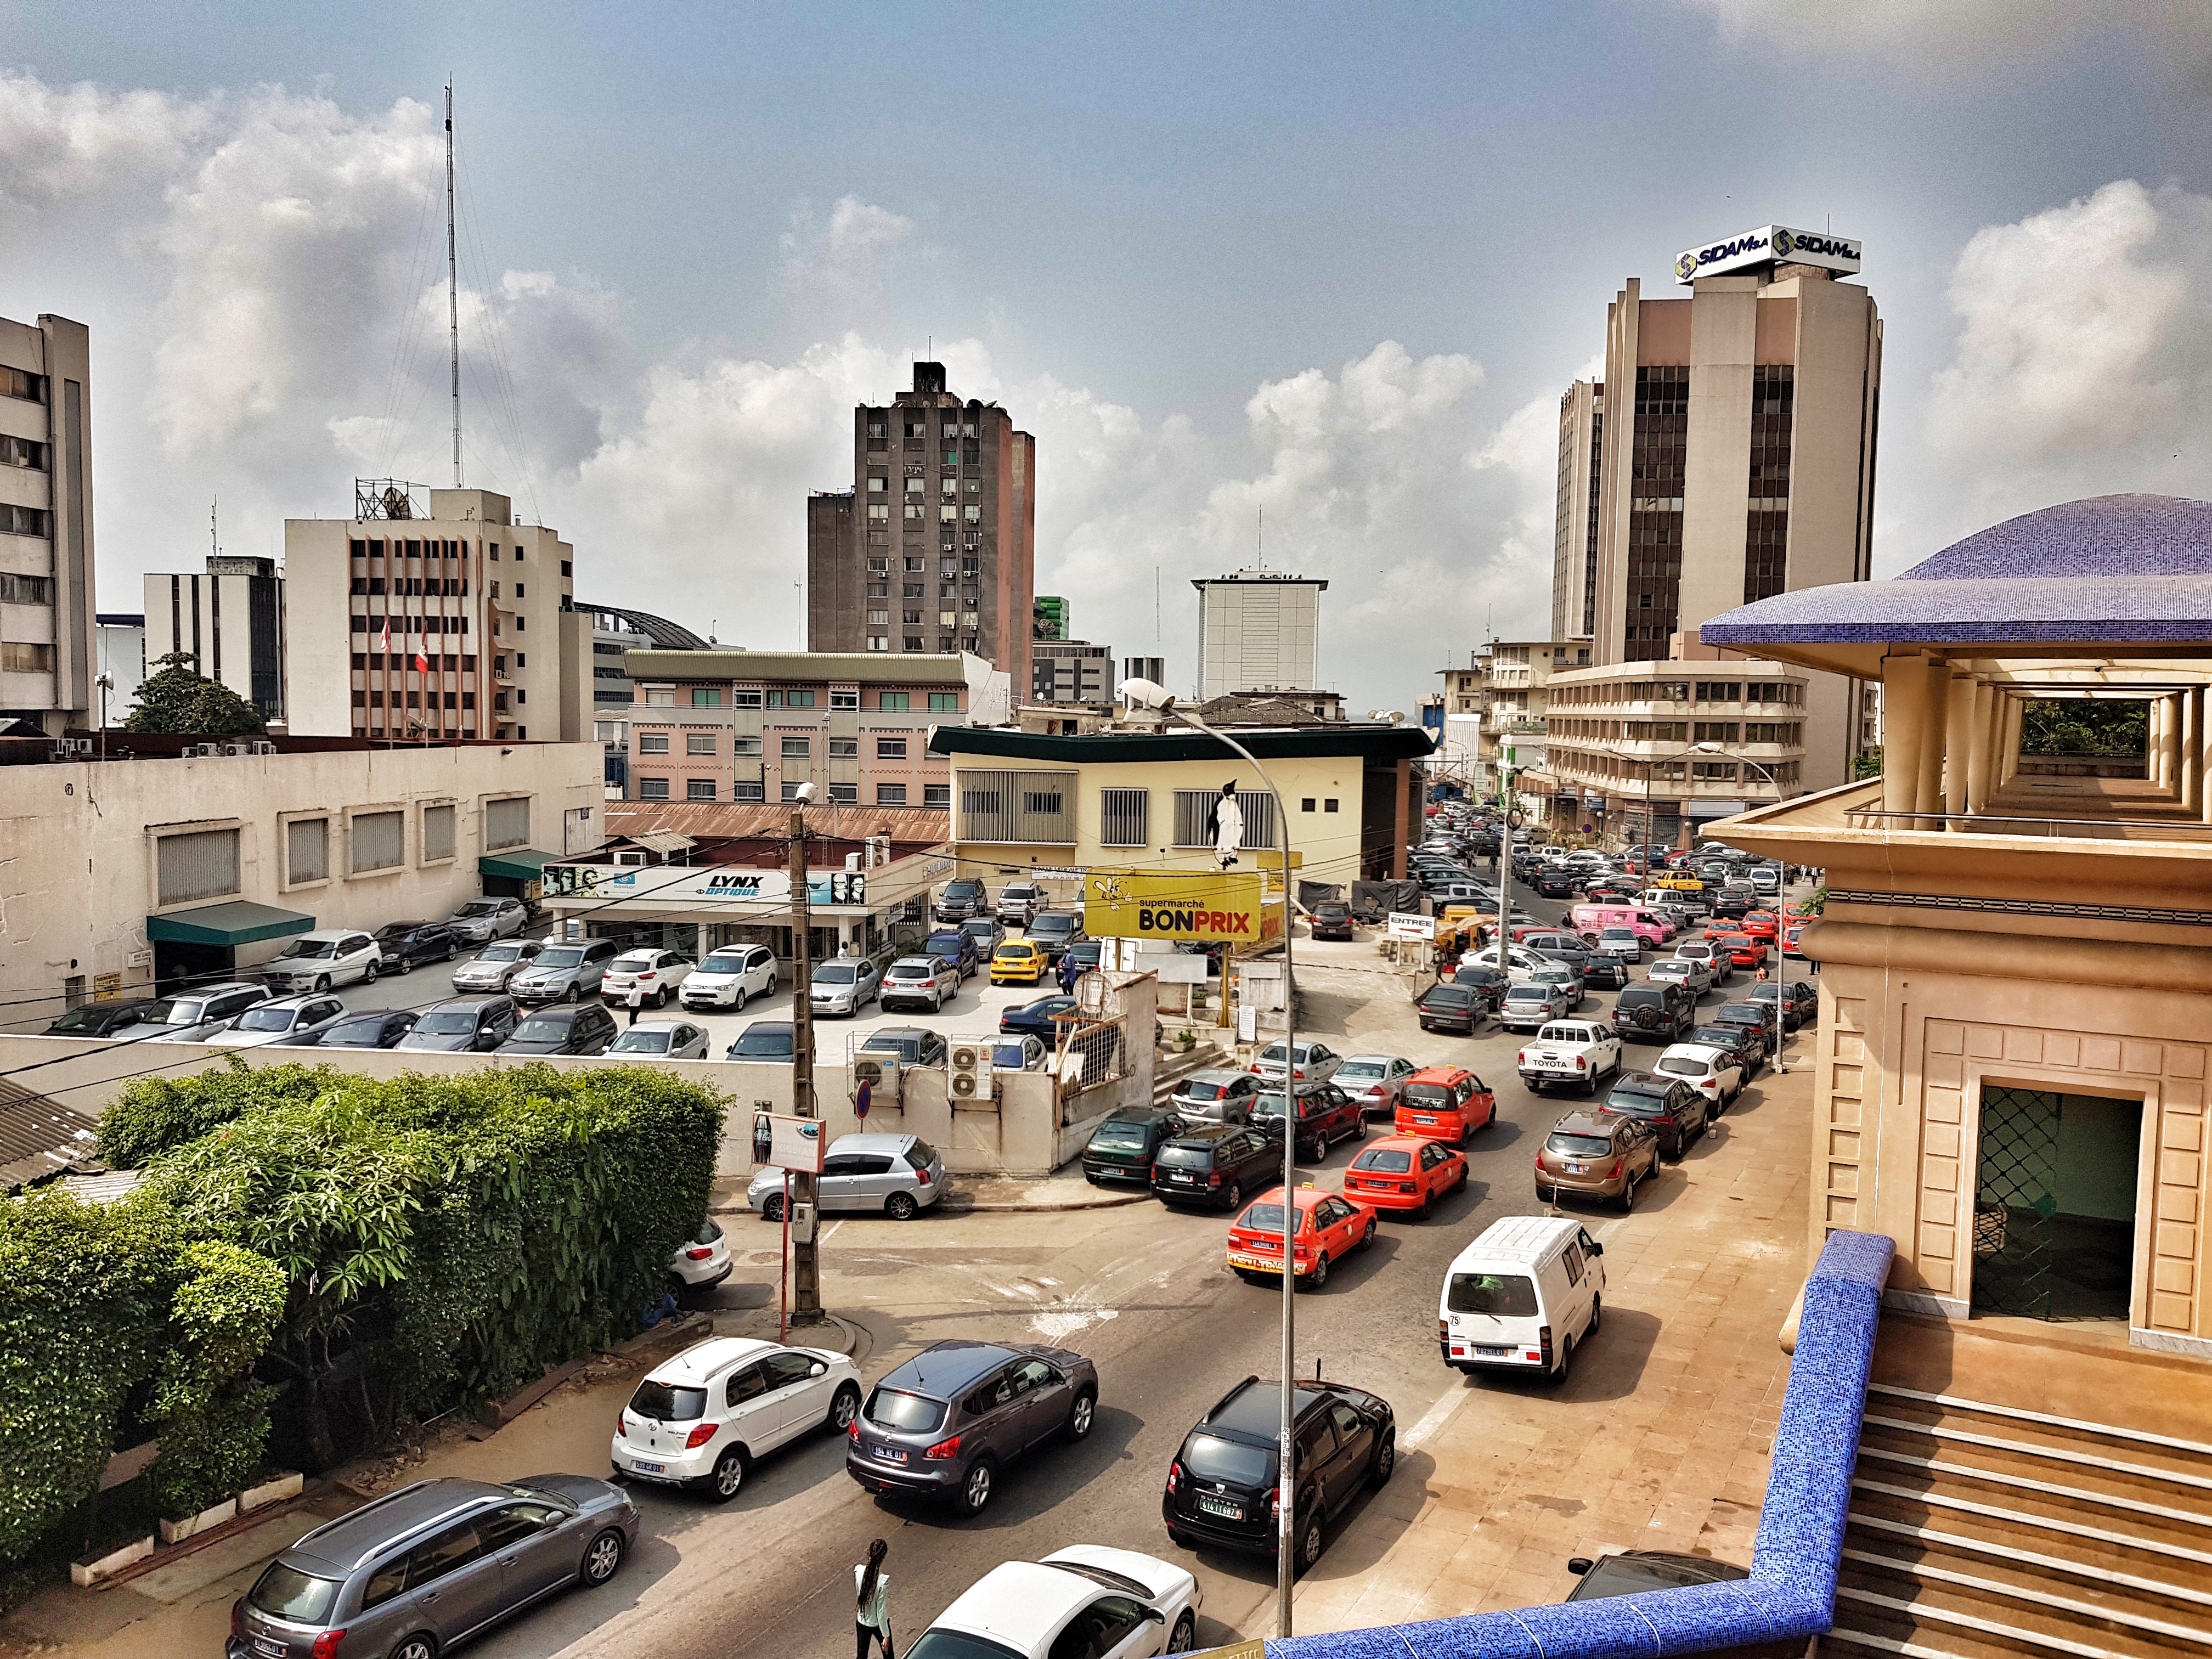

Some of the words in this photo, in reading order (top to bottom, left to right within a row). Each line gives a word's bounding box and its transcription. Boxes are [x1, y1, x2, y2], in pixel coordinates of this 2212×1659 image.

[1697, 235, 1754, 266] SIDAM
[1794, 235, 1849, 258] SIDAM
[709, 876, 764, 888] LYNX
[705, 888, 760, 896] OPTIQUE
[1139, 899, 1205, 909] supermarché
[1139, 909, 1250, 934] BONPRIX
[1391, 916, 1432, 927] ENTRÉE
[1533, 1059, 1567, 1068] TOYOTA
[1451, 1316, 1459, 1324] 75
[1200, 1495, 1238, 1508] DUSTER
